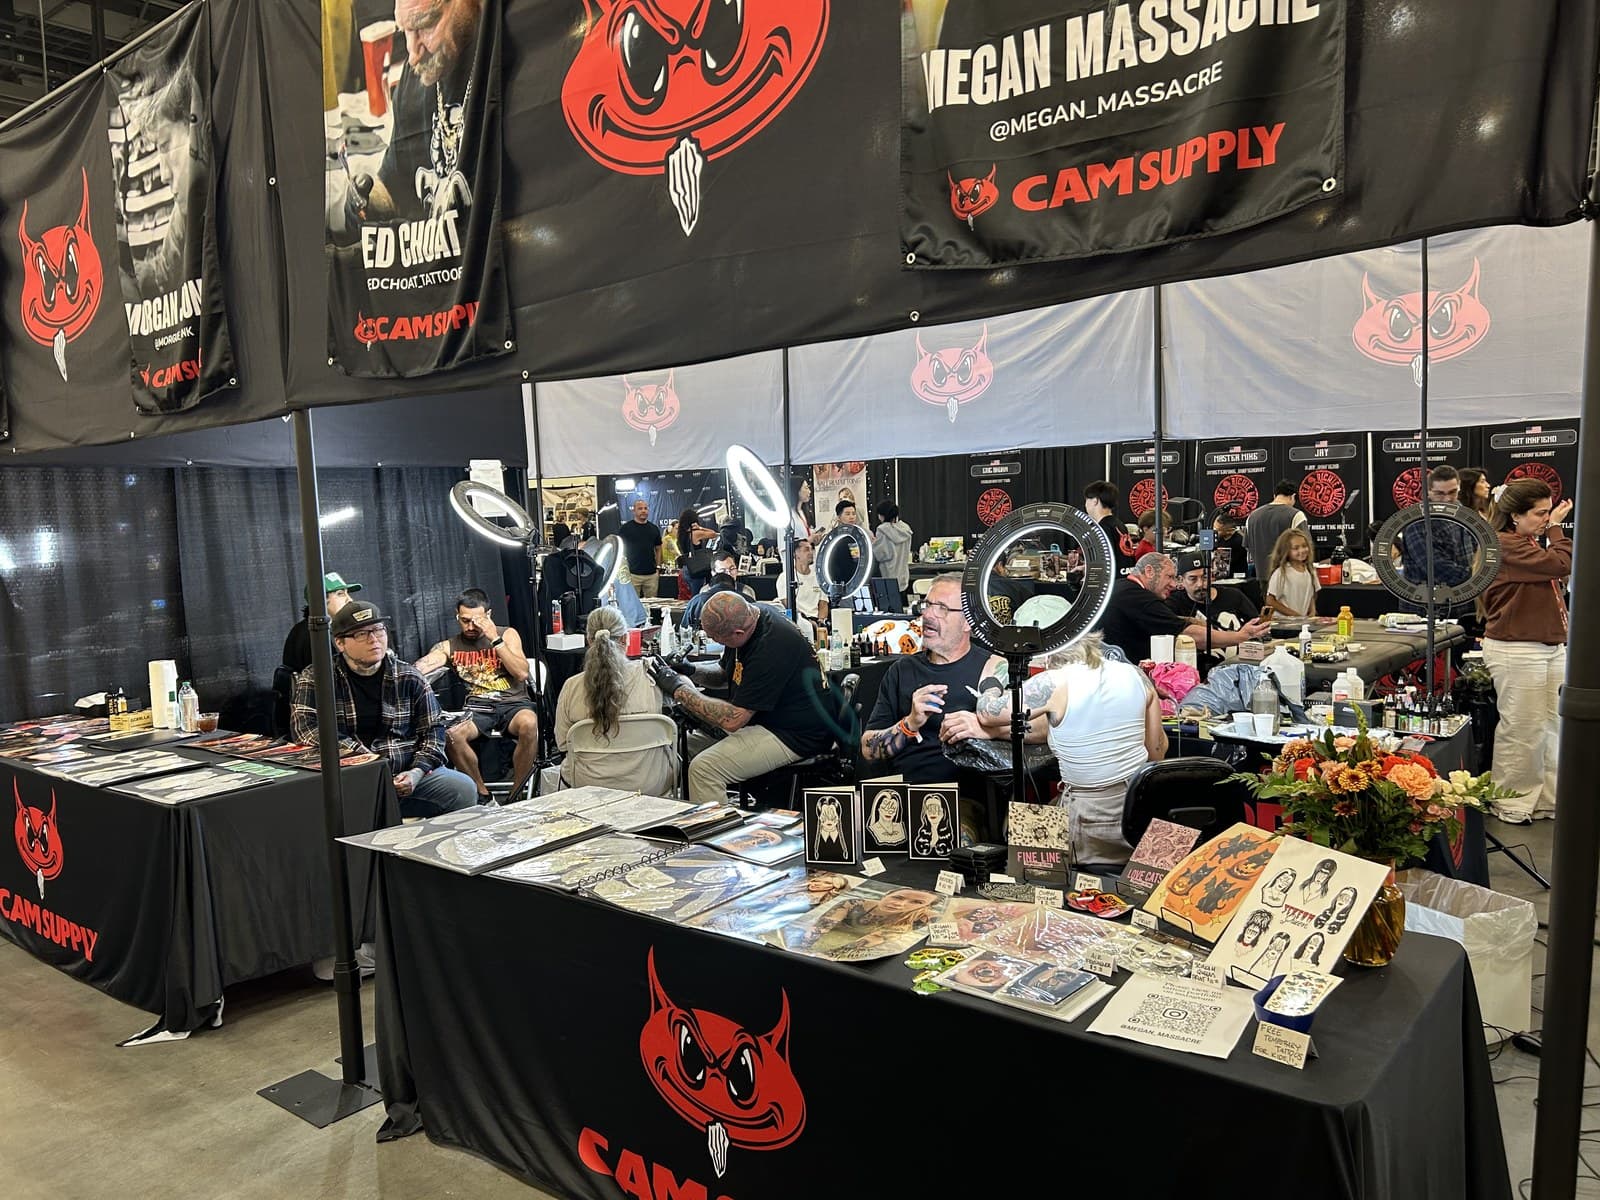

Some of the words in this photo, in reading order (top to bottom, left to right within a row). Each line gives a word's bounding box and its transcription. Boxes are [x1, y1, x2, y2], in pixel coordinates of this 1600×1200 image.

[921, 24, 1052, 114] MEGAN
[989, 60, 1224, 142] @MEGAN_MASSACRE
[361, 226, 395, 269] ED
[398, 209, 461, 268] CHOAT
[1213, 454, 1240, 463] MASTER
[1314, 448, 1329, 457] JAY
[1017, 851, 1038, 863] FINE
[1041, 851, 1061, 864] LINE
[1127, 869, 1146, 881] LOVE
[1145, 871, 1164, 884] CATS
[1260, 1023, 1282, 1037] FREE
[578, 1126, 735, 1200] CAM
